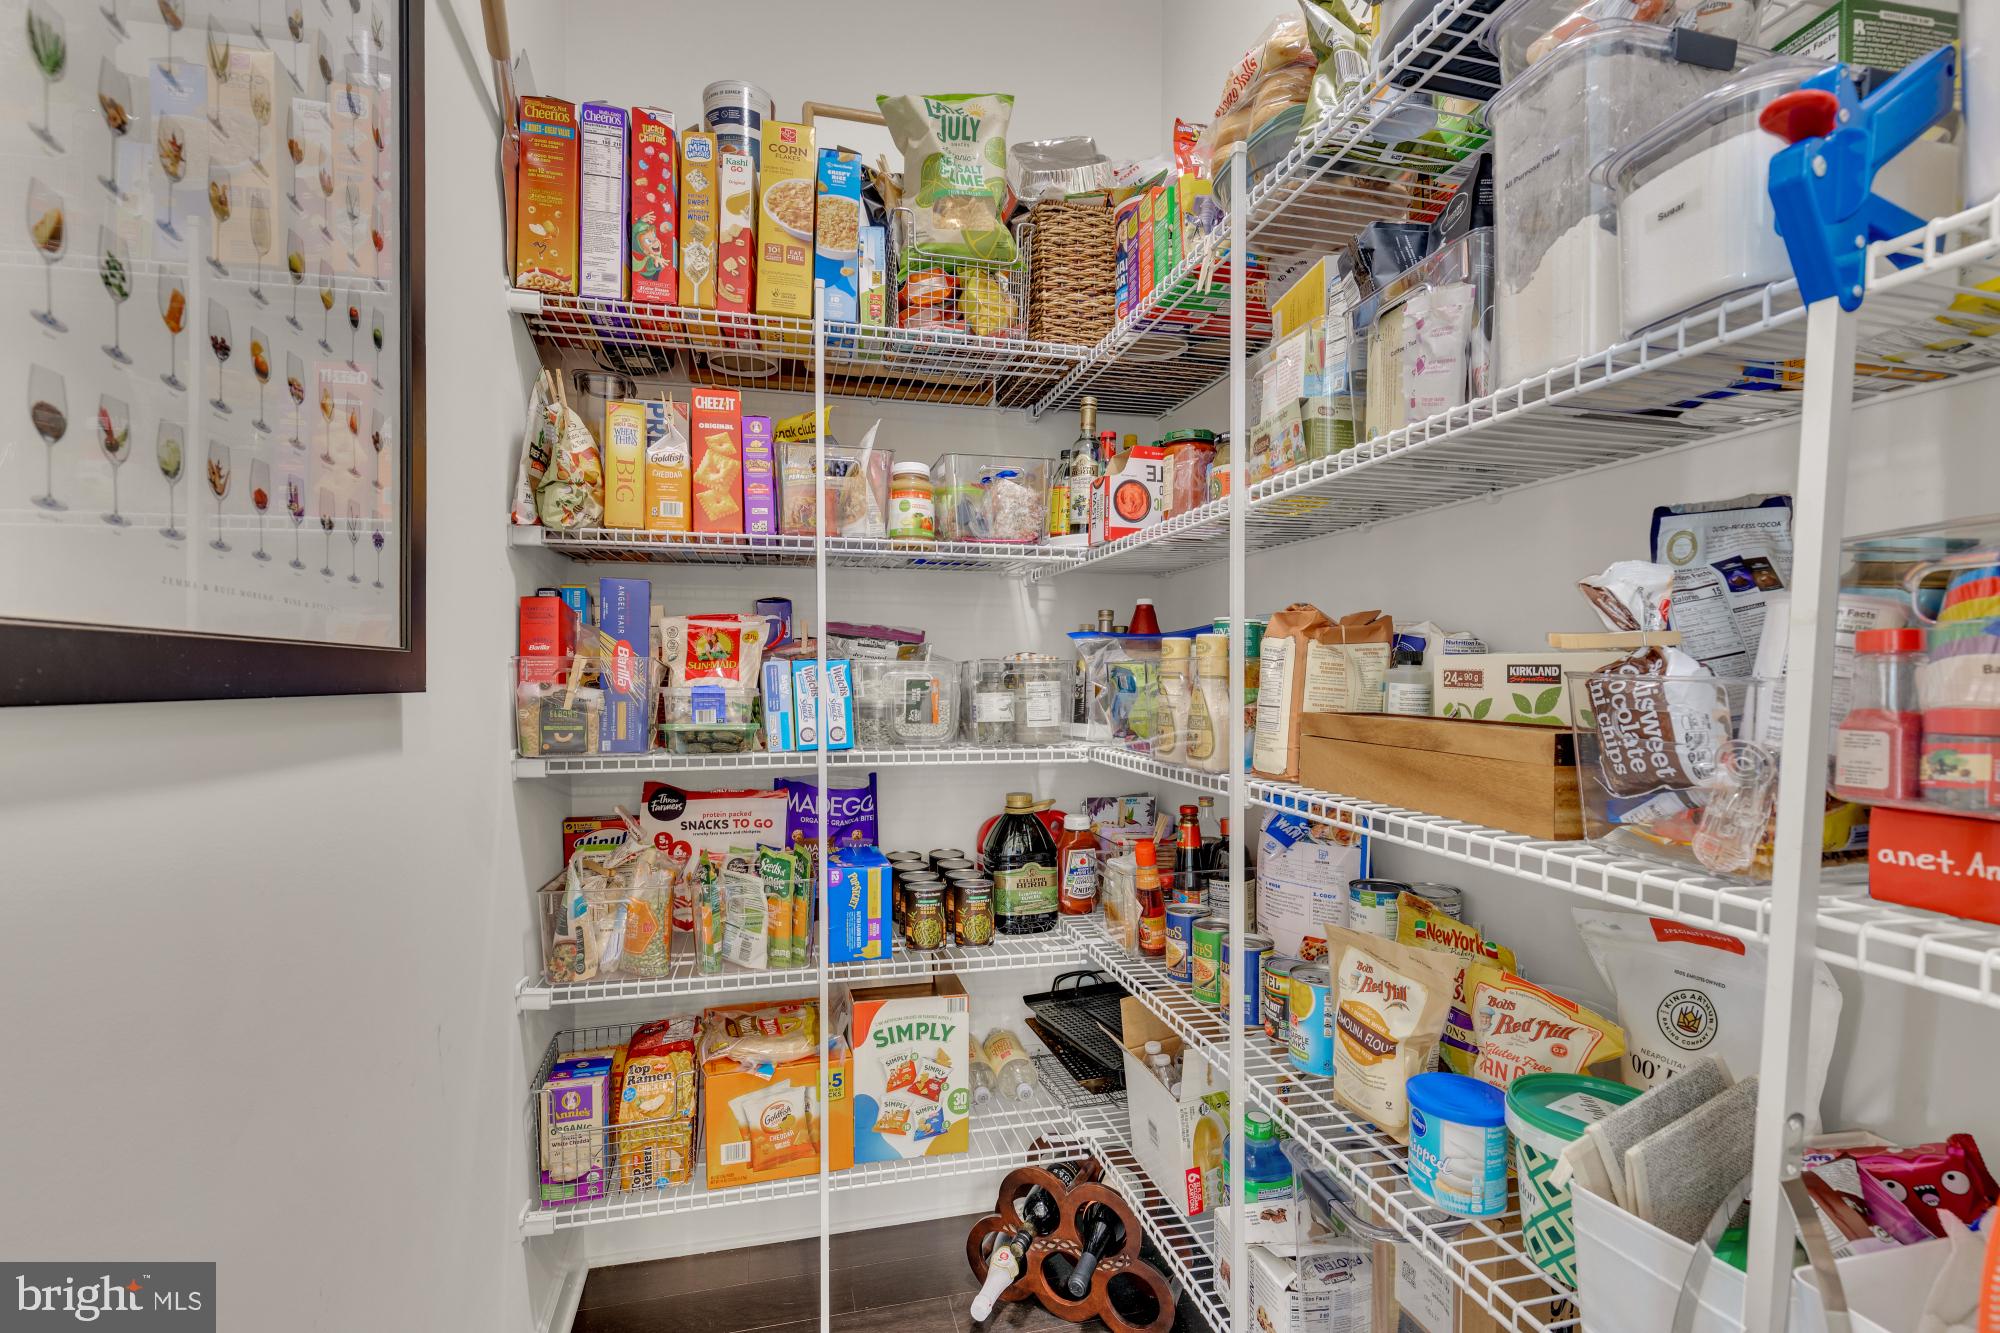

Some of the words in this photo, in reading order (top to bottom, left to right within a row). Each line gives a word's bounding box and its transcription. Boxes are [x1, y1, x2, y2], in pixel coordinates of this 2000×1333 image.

[1814, 32, 1836, 50] Facts
[524, 104, 570, 123] Cheerios
[584, 109, 621, 124] Cheerios
[642, 124, 664, 137] Lucky
[937, 114, 980, 143] JULY
[638, 132, 667, 146] Charms
[688, 143, 709, 152] Mini
[768, 144, 807, 157] CORN
[687, 151, 710, 159] Wheats
[725, 157, 748, 167] Kashi
[959, 164, 982, 174] SALT
[1504, 180, 1512, 190] All
[1513, 162, 1541, 184] Purpose
[1542, 149, 1560, 164] Flour
[950, 168, 984, 188] LIME
[614, 427, 637, 436] WHEAT
[798, 422, 816, 436] club
[651, 452, 684, 464] Goldfish
[616, 457, 636, 504] BIG
[652, 470, 683, 478] CHEDDAR
[1712, 587, 1722, 596] 15
[1847, 608, 1876, 620] Facts
[618, 646, 630, 688] Barilla
[1509, 666, 1560, 676] KIRKLAND
[803, 666, 818, 697] Welch's
[832, 666, 848, 696] Welch's
[1444, 672, 1458, 685] 24
[1598, 712, 1627, 775] chips
[659, 793, 679, 804] Three
[651, 801, 683, 812] Farmers
[728, 810, 752, 818] packed
[680, 819, 729, 831] SNACKS
[733, 819, 750, 829] TO
[754, 818, 773, 829] GO
[761, 858, 781, 875] Seeds
[1664, 927, 1704, 938] SPECIALTY
[1356, 961, 1374, 974] Bob's
[1674, 969, 1686, 977] 100%
[1358, 976, 1384, 993] Red
[1383, 982, 1408, 1002] Mill
[1487, 995, 1516, 1011] Bob's
[1664, 993, 1687, 1010] KING
[1690, 993, 1714, 1023] ARTHUR
[1492, 1013, 1537, 1036] Red
[1530, 1020, 1579, 1043] Mill
[1663, 1017, 1679, 1041] BAKING
[1682, 1033, 1709, 1046] COMPANY
[872, 1022, 956, 1048] SIMPLY
[886, 1055, 908, 1066] SIMPLY
[1484, 1040, 1521, 1063] Gluten
[1520, 1055, 1553, 1073] Free
[629, 1064, 650, 1076] Top
[924, 1065, 946, 1076] SIMPLY
[627, 1072, 672, 1086] Ramen
[954, 1092, 967, 1105] 30
[884, 1101, 907, 1110] SIMPLY
[916, 1104, 938, 1116] SIMPLY
[555, 1107, 591, 1120] Annie's
[764, 1105, 792, 1126] Goldfish
[551, 1124, 592, 1136] ORGANIC
[769, 1128, 795, 1142] CHEDDAR
[642, 1147, 652, 1191] Ramen
[632, 1165, 644, 1190] Top
[1188, 1173, 1200, 1183] 6
[1188, 1184, 1197, 1213] CARTONS
[1314, 1254, 1364, 1274] PROTEIN
